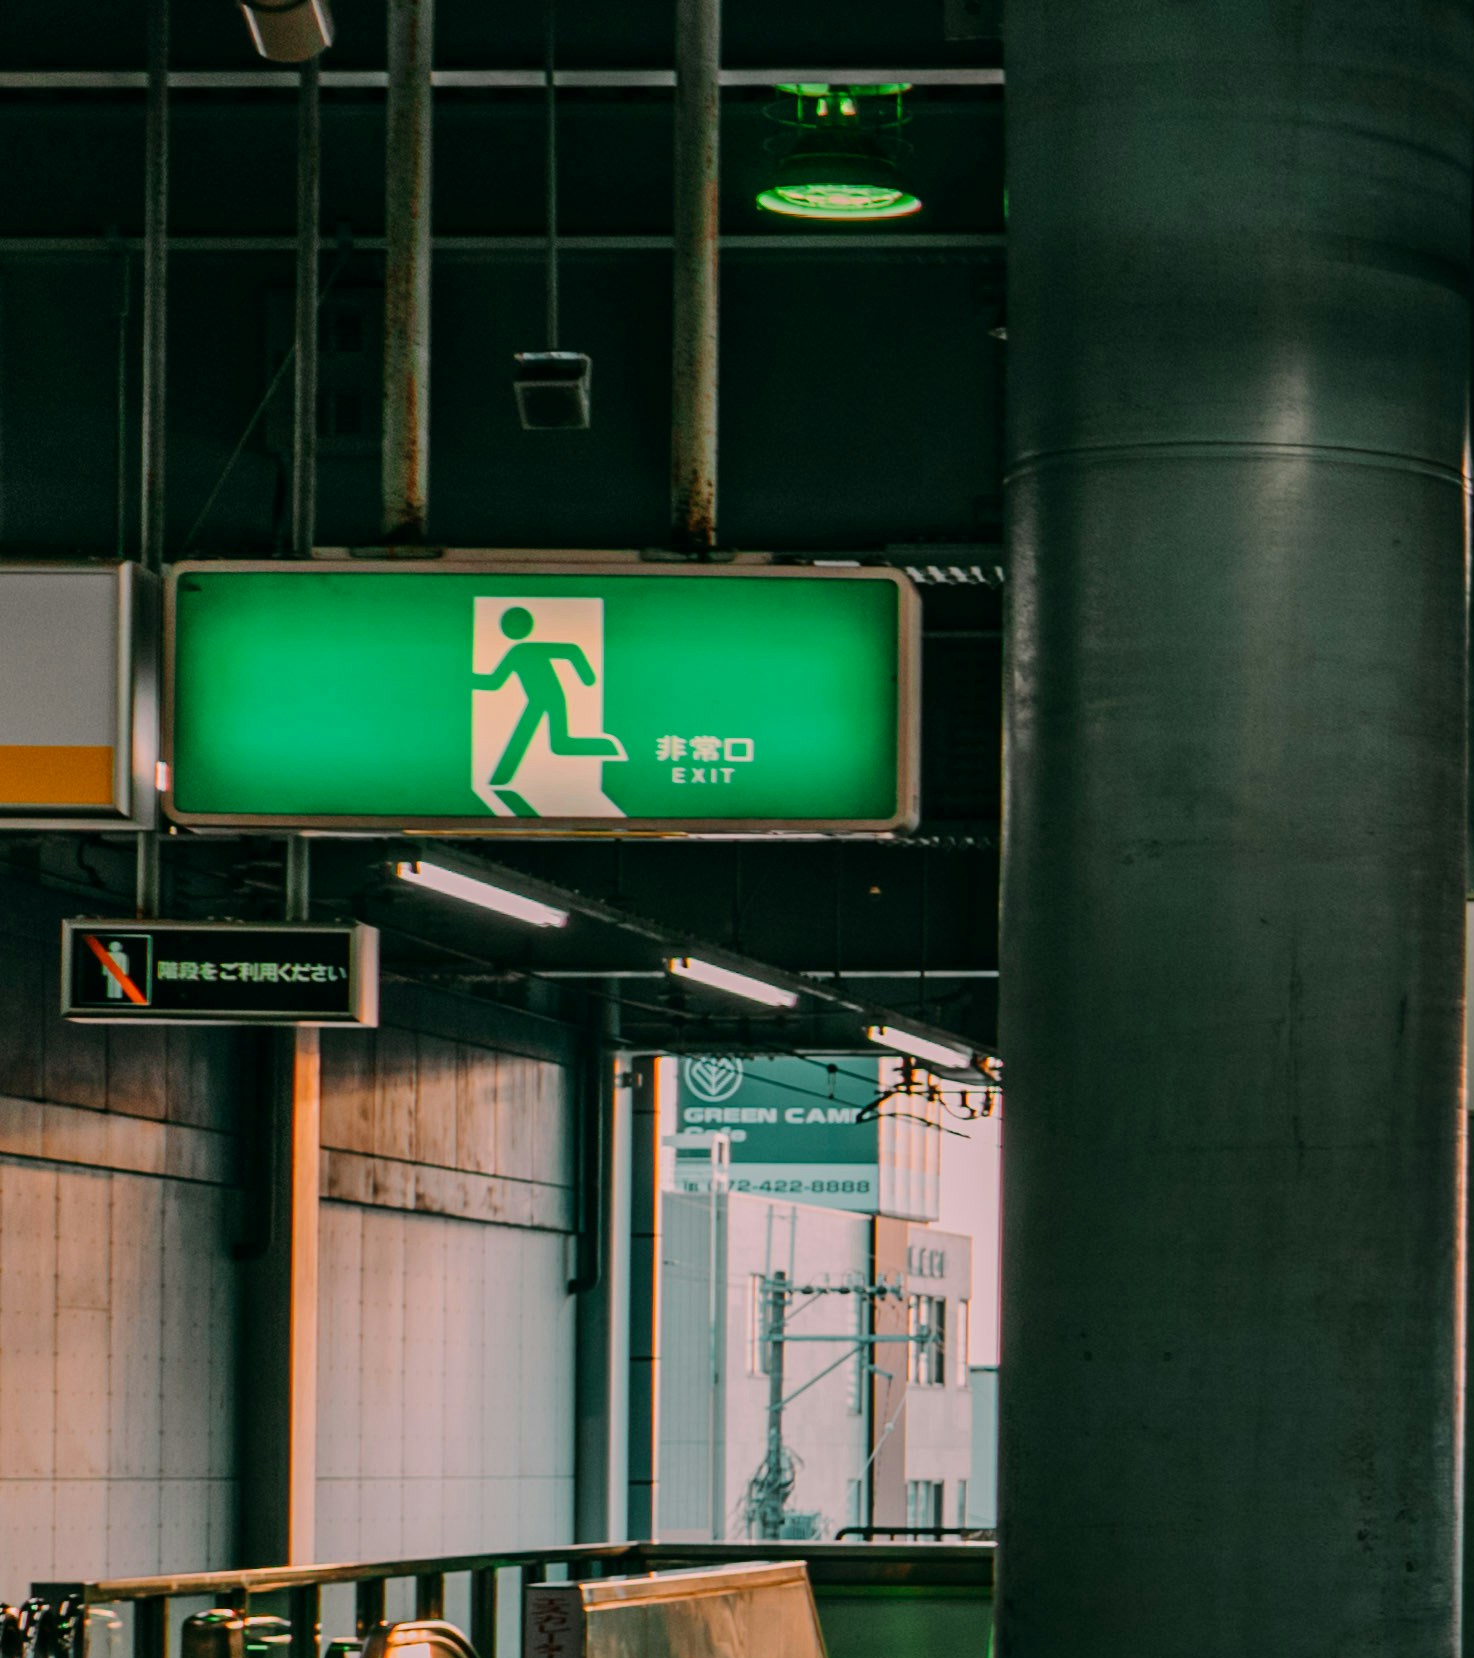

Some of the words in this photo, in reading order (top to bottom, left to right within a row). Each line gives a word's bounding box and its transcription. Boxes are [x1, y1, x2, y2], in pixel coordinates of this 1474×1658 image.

[656, 735, 754, 762] 非常口
[671, 767, 735, 783] EXIT
[157, 960, 348, 983] 階段をご利用ください
[683, 1107, 778, 1124] GREEN
